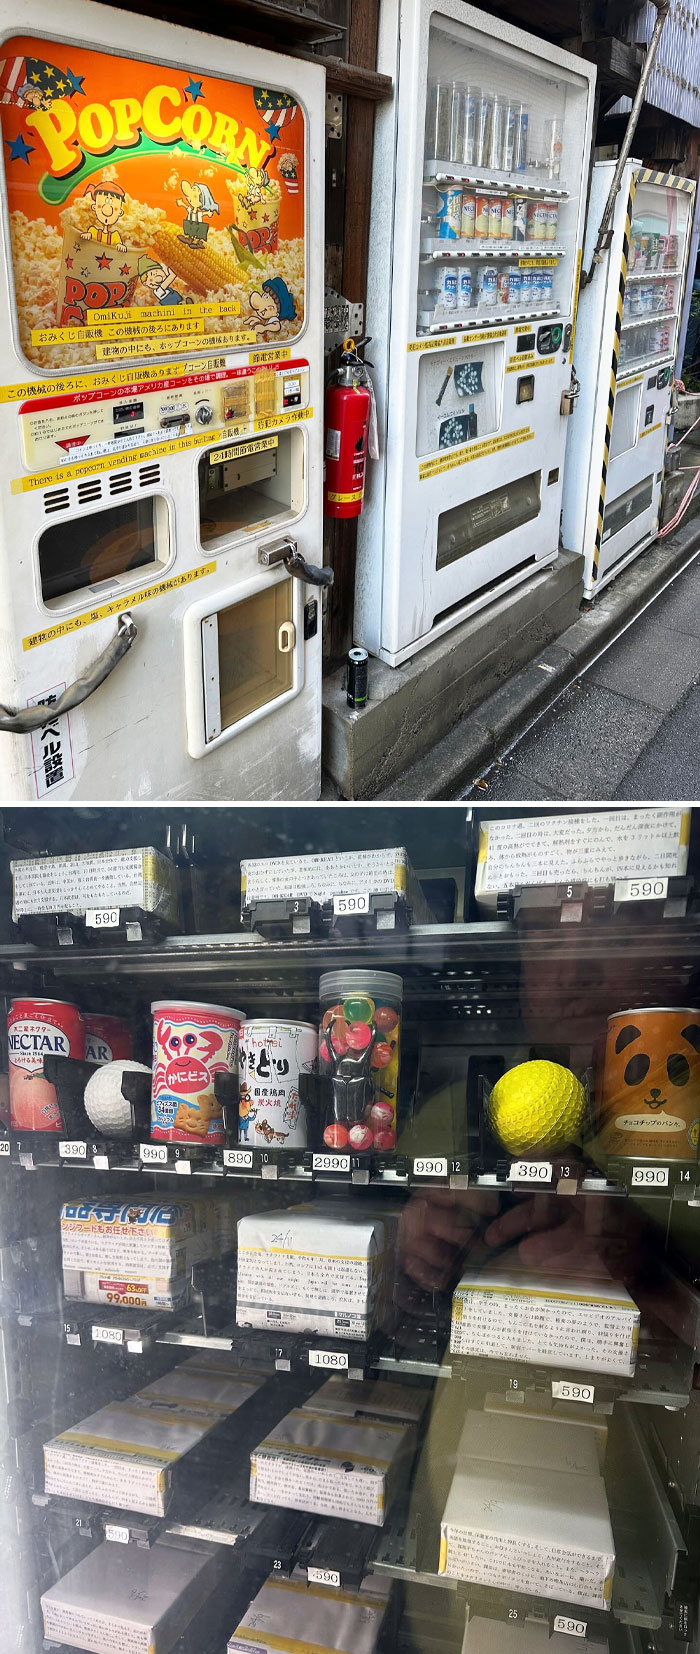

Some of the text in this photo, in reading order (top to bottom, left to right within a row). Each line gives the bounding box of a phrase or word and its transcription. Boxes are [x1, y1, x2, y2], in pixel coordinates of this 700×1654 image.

[26, 85, 271, 172] POPCORN
[566, 885, 573, 898] 5
[629, 882, 664, 897] 590
[294, 901, 299, 912] 3
[338, 897, 366, 912] 590
[8, 1034, 67, 1053] NECTAR
[168, 1070, 208, 1086] かにビス
[254, 1087, 286, 1097] 国産鶏肉
[258, 1099, 281, 1107] 炭火焼
[64, 1144, 85, 1156] 390
[143, 1148, 166, 1160] 990
[175, 1149, 180, 1157] 9
[228, 1152, 252, 1164] 890
[260, 1153, 269, 1162] 10
[314, 1156, 349, 1169] 2990
[416, 1161, 443, 1172] 990
[451, 1161, 460, 1172] 12
[518, 1164, 548, 1179] 390
[560, 1165, 570, 1177] 13
[634, 1170, 666, 1183] 990
[679, 1170, 691, 1182] 14
[64, 1323, 71, 1332] 15
[95, 1328, 123, 1341] 1080
[314, 1353, 346, 1367] 1080
[509, 1378, 518, 1389] 19
[561, 1386, 591, 1400] 590
[273, 1559, 282, 1570] 23
[508, 1608, 518, 1620] 25
[557, 1618, 585, 1635] 590
